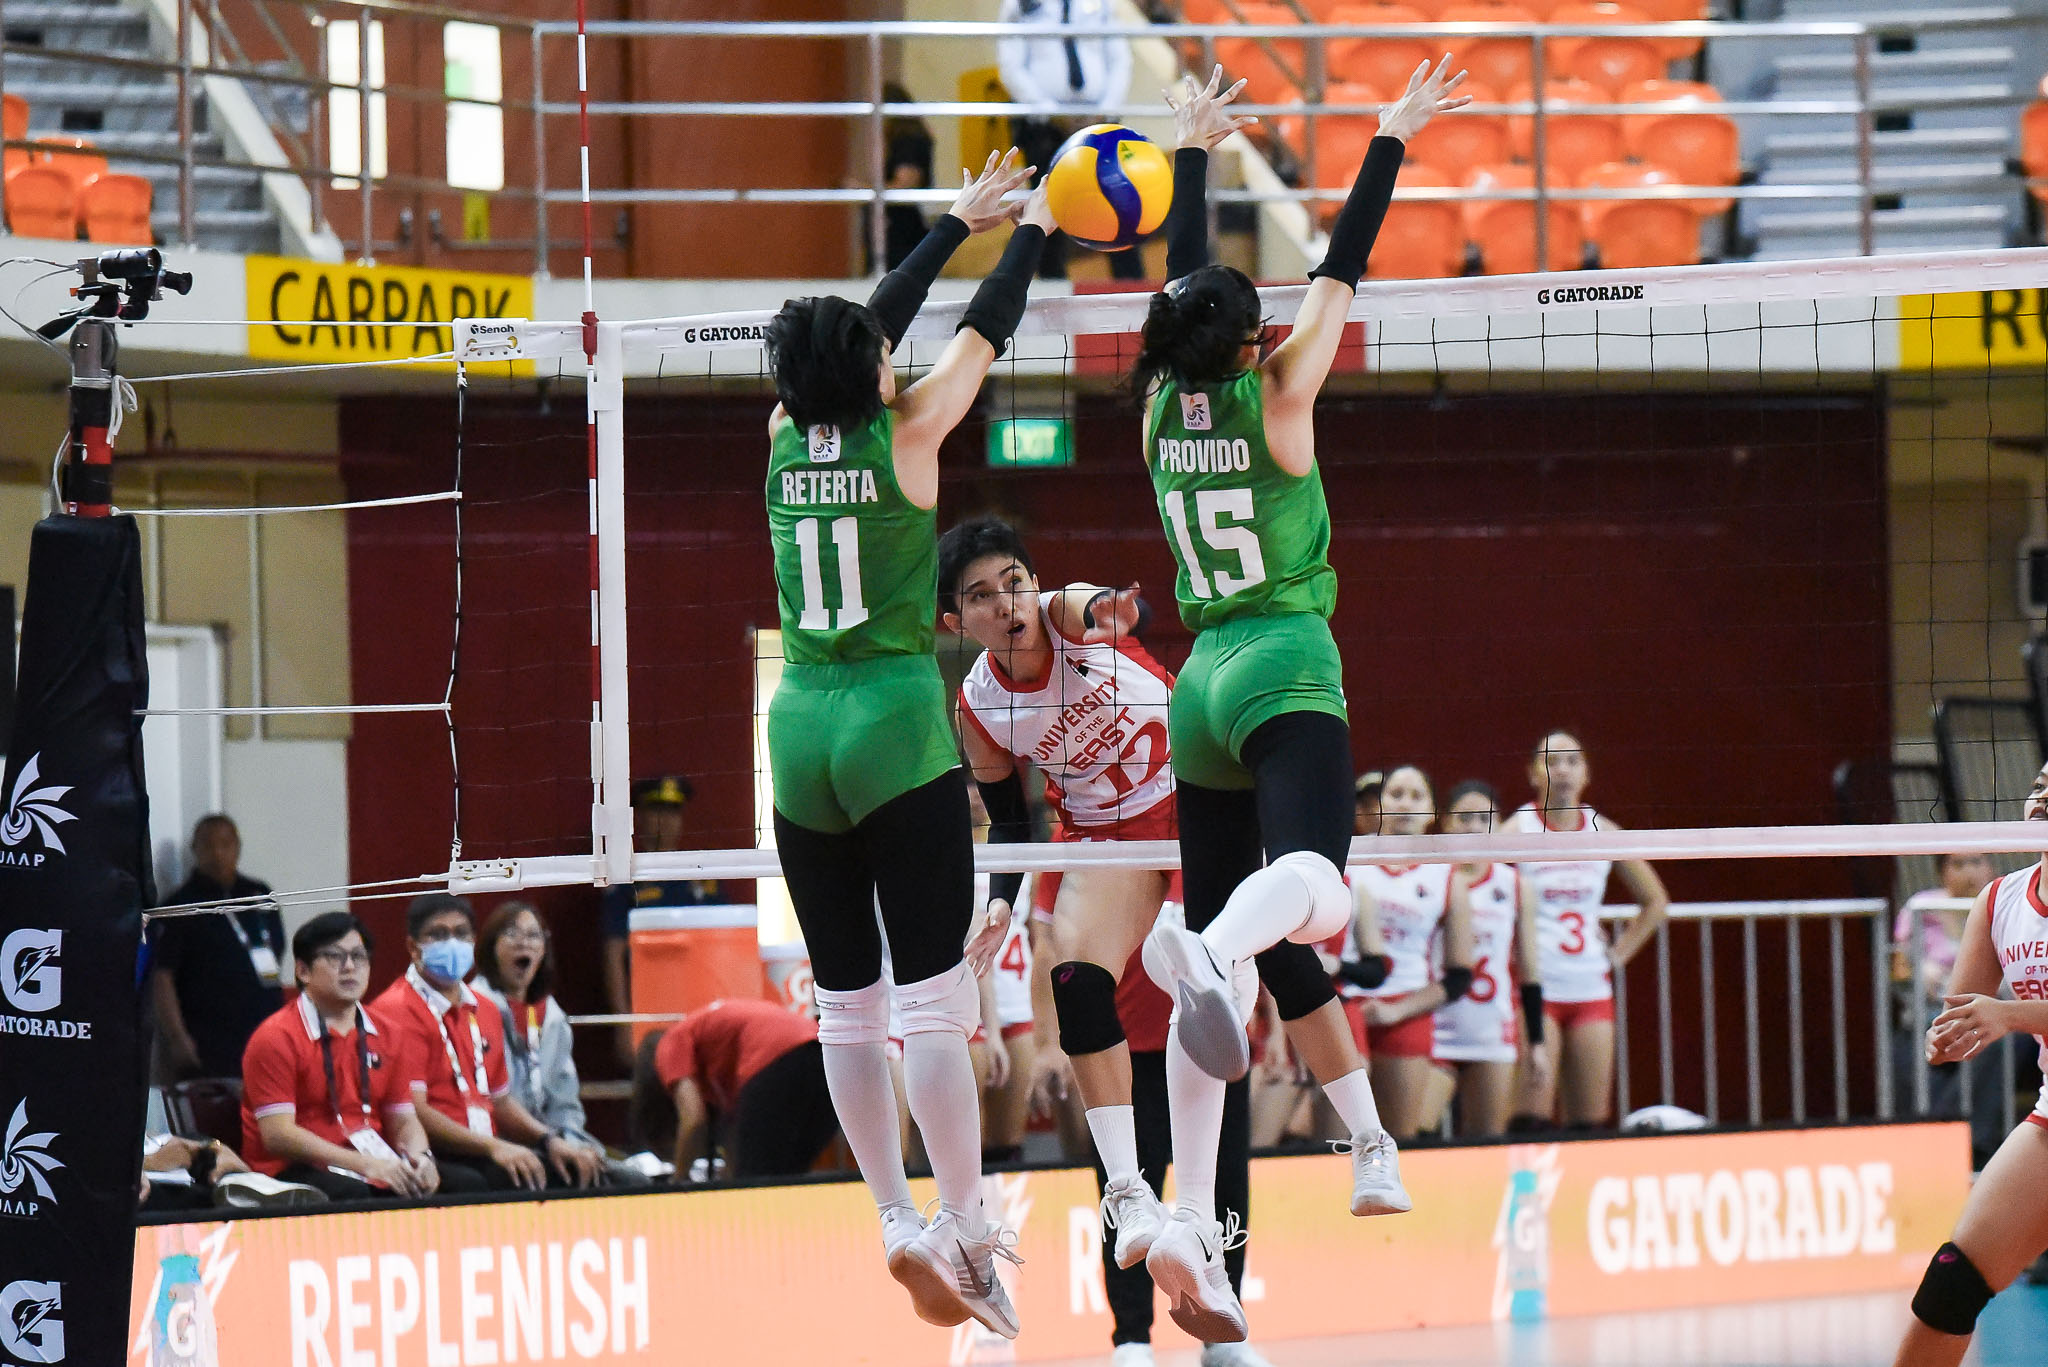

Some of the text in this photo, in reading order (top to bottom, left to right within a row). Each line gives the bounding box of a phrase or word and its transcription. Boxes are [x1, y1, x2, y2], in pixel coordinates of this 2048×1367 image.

[1554, 285, 1644, 303] GATORADE
[480, 324, 515, 334] Senoh
[700, 326, 768, 342] GATORA
[1158, 438, 1250, 473] PROVIDO
[781, 469, 878, 504] RETERTA
[1165, 488, 1266, 599] 15
[795, 516, 869, 630] 11
[1033, 675, 1120, 761] UNIVERSITY
[1075, 715, 1106, 744] OF THE
[1067, 706, 1136, 771] EAST
[1088, 721, 1172, 810] 12
[1558, 911, 1584, 955] 3
[2000, 941, 2048, 969] UNIVE
[2025, 966, 2037, 975] OF
[1588, 1162, 1896, 1275] GATORADE
[288, 1235, 650, 1367] REPLENISH
